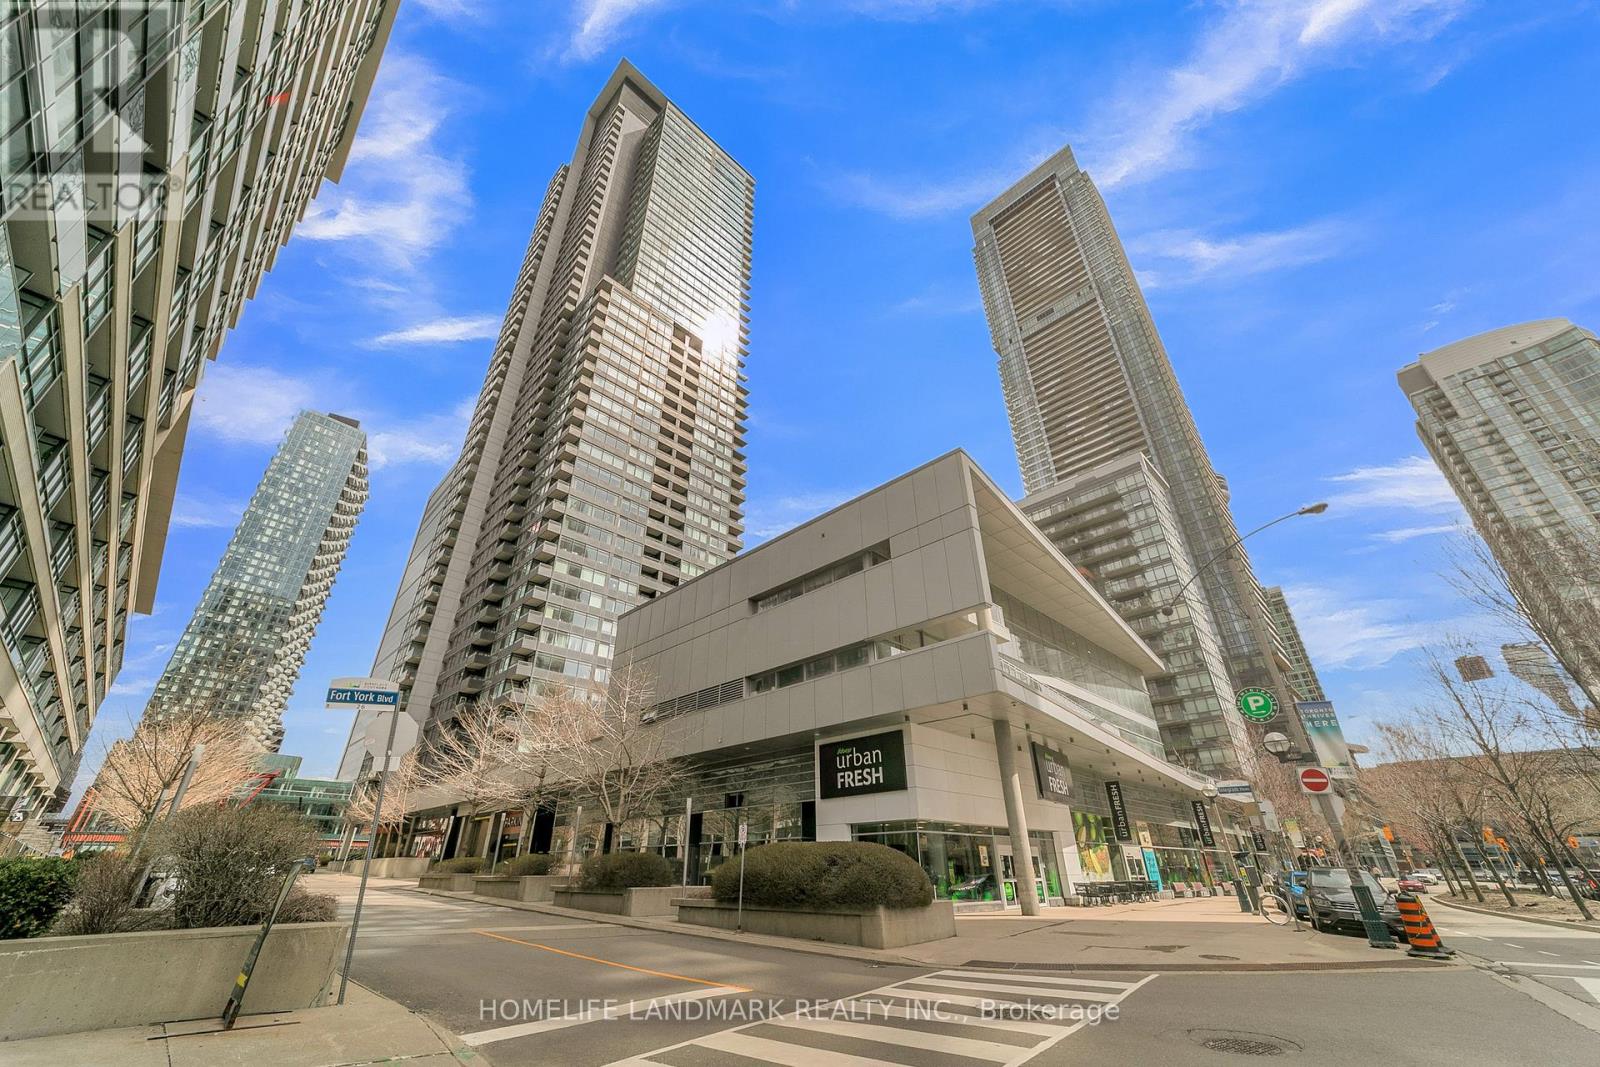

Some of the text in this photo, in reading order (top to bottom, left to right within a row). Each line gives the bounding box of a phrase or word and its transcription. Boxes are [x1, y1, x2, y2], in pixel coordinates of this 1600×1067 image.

[330, 690, 394, 703] Fort York Blvd
[836, 747, 882, 769] urban
[836, 767, 884, 789] FRESH
[1049, 776, 1070, 796] FRESH
